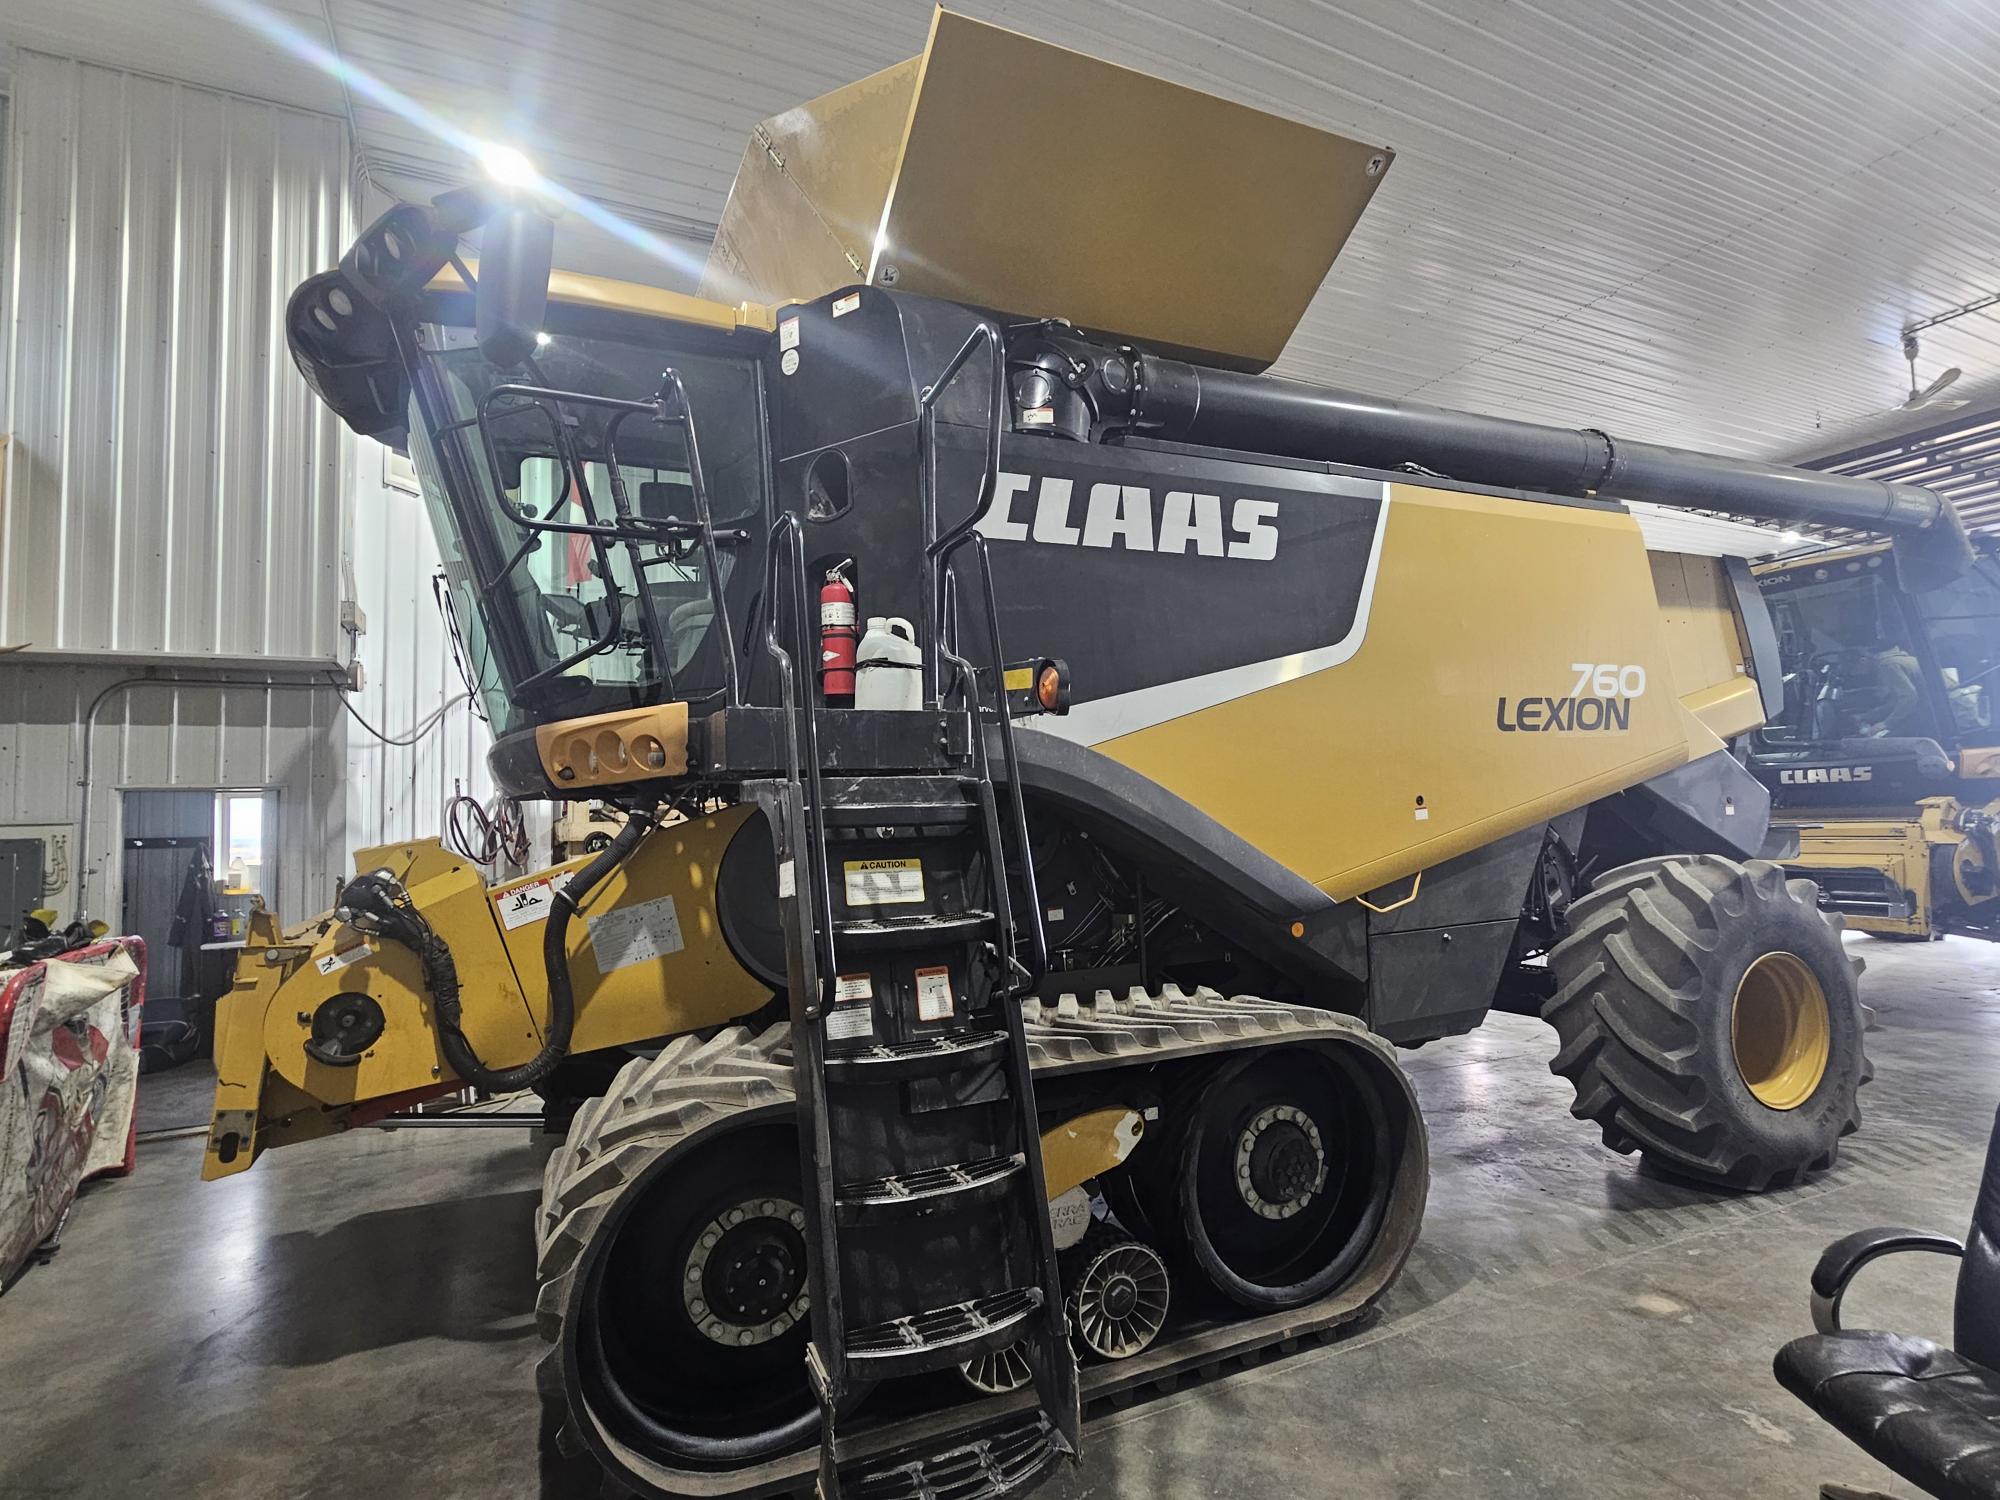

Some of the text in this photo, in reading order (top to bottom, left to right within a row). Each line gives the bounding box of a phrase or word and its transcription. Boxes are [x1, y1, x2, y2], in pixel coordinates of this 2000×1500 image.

[972, 472, 1279, 561] CLAAS
[1757, 574, 1791, 587] XION
[1571, 663, 1646, 698] 760
[1496, 697, 1630, 732] LEXION
[1780, 766, 1872, 784] CLAAS
[869, 860, 906, 869] CAUTION
[510, 881, 540, 895] DANGER
[1050, 1204, 1086, 1218] ERRA
[1052, 1216, 1081, 1230] RAC
